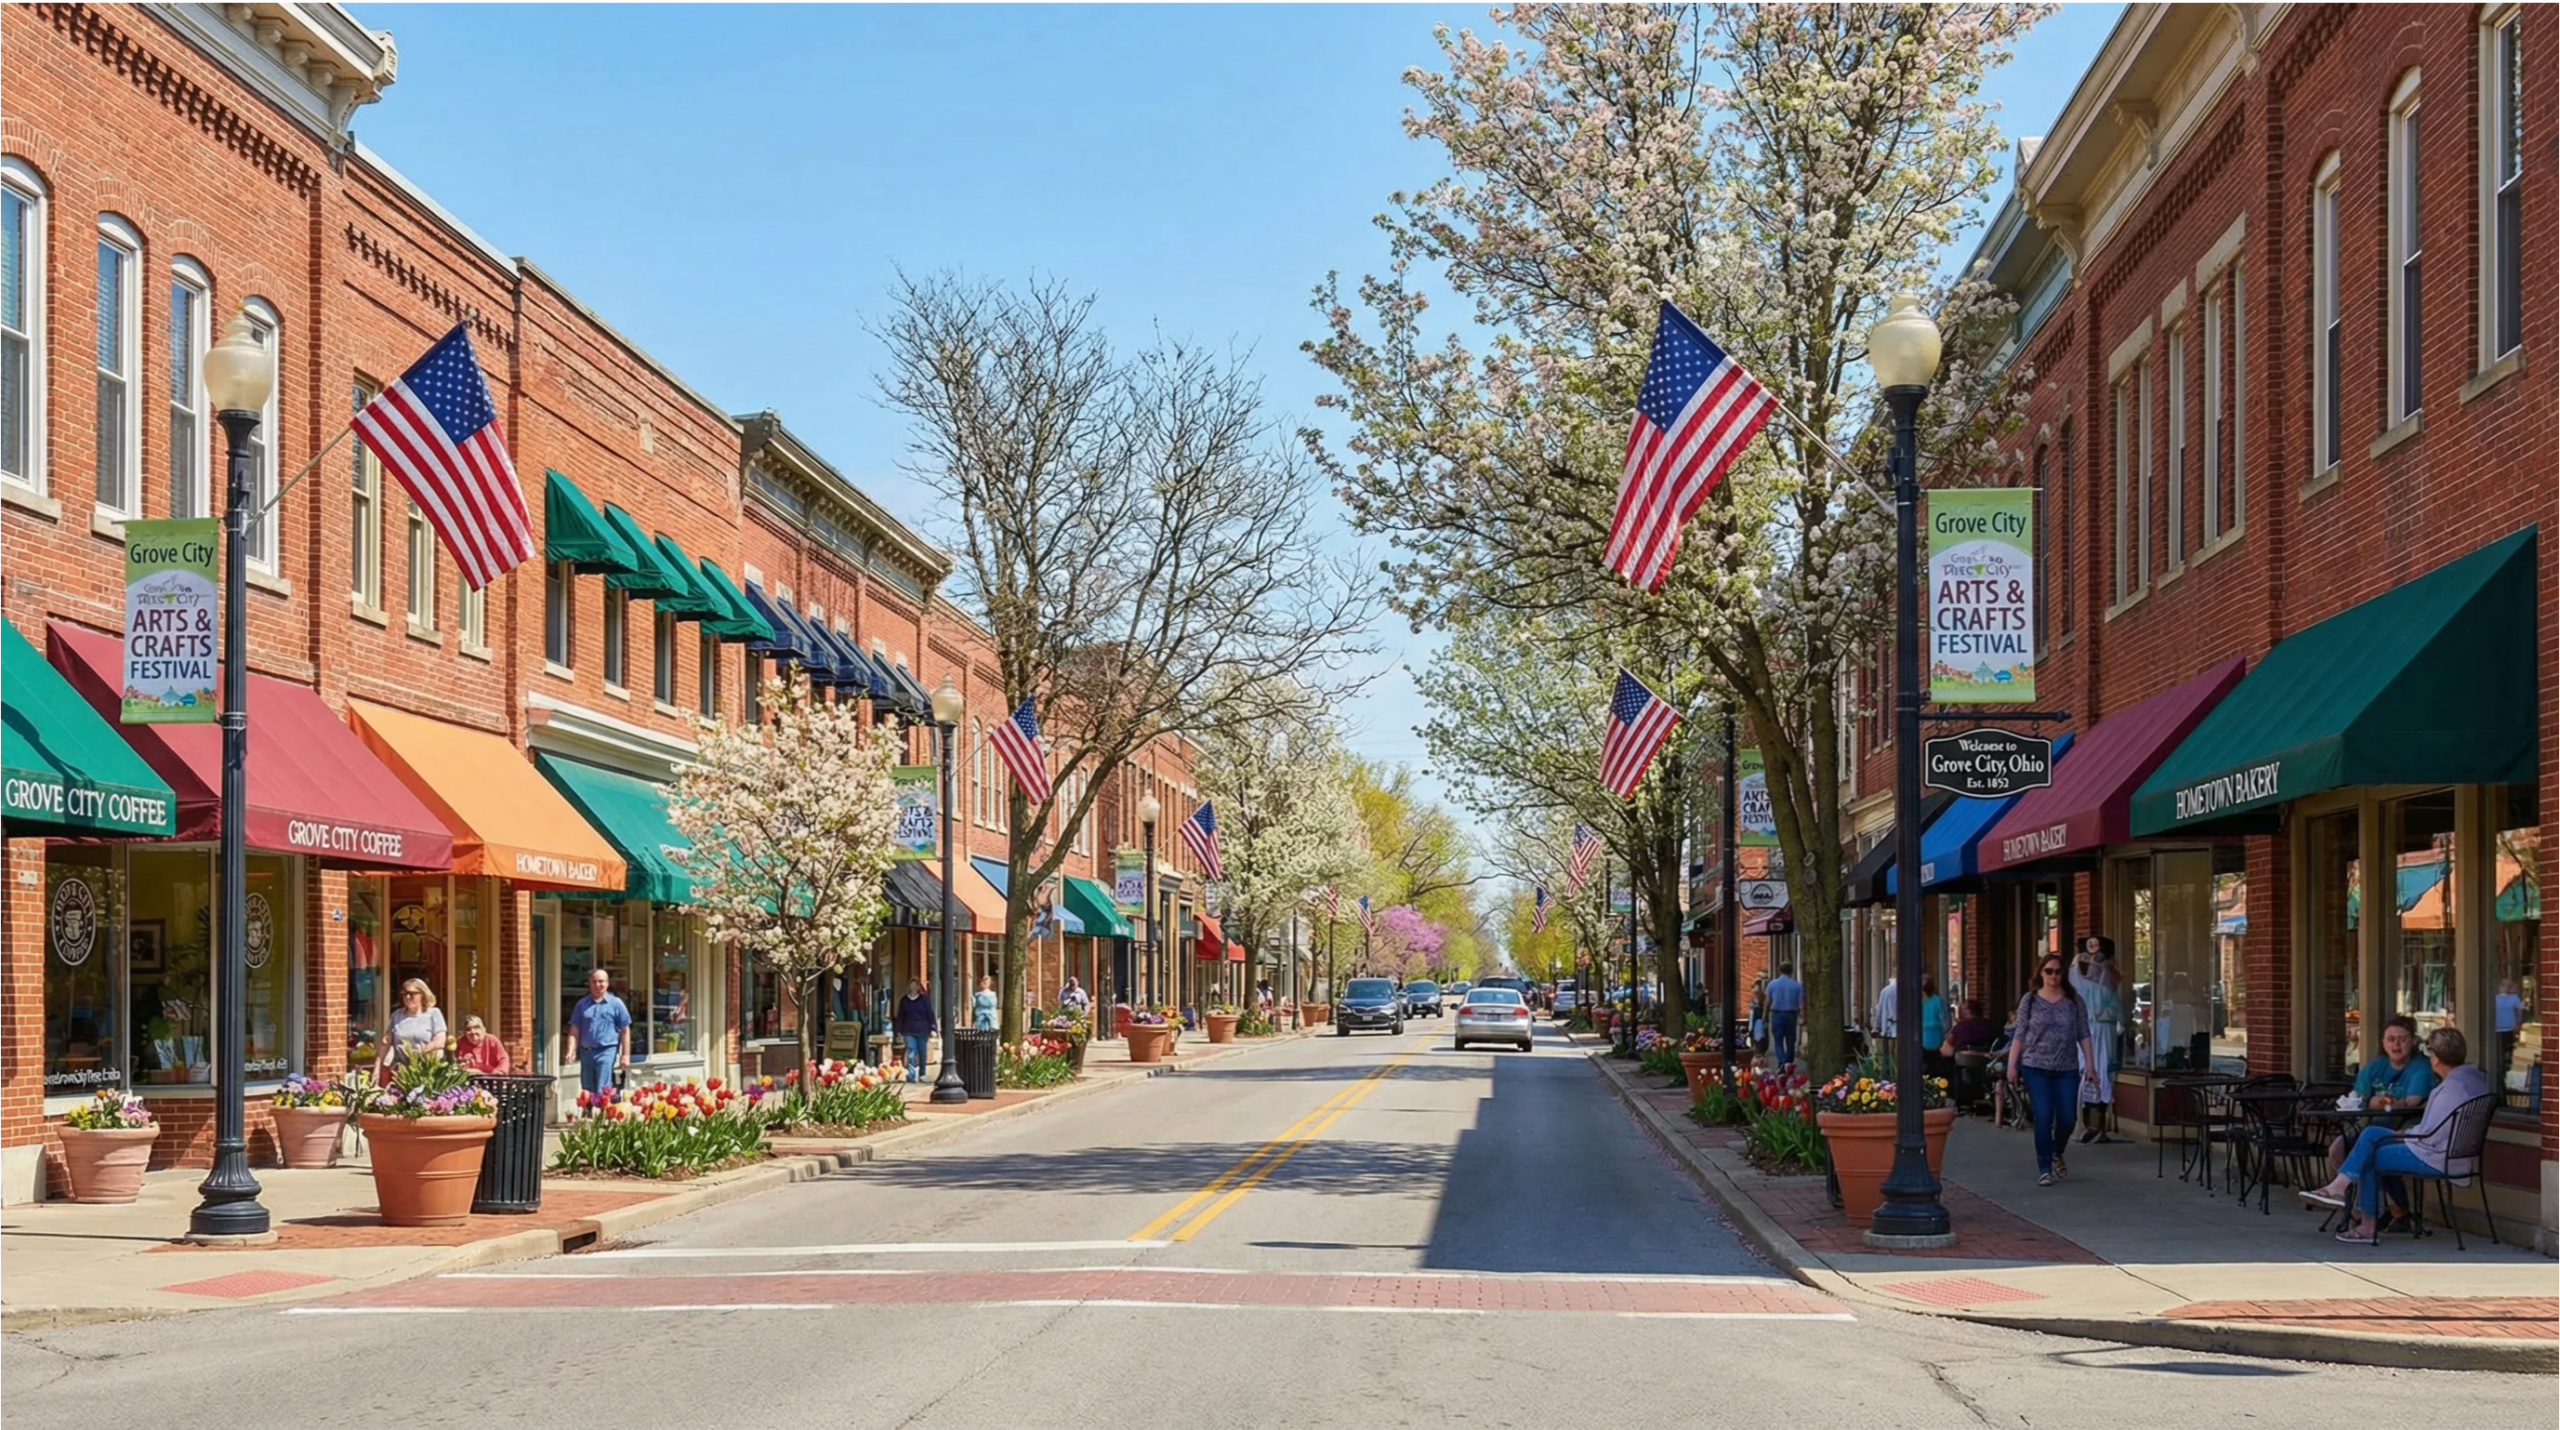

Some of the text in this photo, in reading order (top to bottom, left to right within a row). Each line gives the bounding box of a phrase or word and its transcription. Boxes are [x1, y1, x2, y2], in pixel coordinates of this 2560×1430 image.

[1935, 511, 2027, 538] Grove City
[129, 541, 214, 567] Grove City
[1937, 579, 2025, 604] ARTS &
[131, 607, 212, 632] ARTS &
[1936, 606, 2026, 631] CRAFTS
[130, 634, 212, 657] CRAFTS
[1937, 633, 2028, 654] FESTIVAL
[130, 660, 212, 679] FESTIVAL
[1957, 738, 2018, 752] Welcome to
[1931, 753, 2045, 778] Grove City, Ohio
[1966, 777, 1985, 788] Est.
[2175, 761, 2281, 820] HOMETOWN BAKERY
[5, 777, 167, 826] GROVE CITY COFFEE
[287, 819, 331, 849] GROVE
[331, 826, 359, 852] CITY
